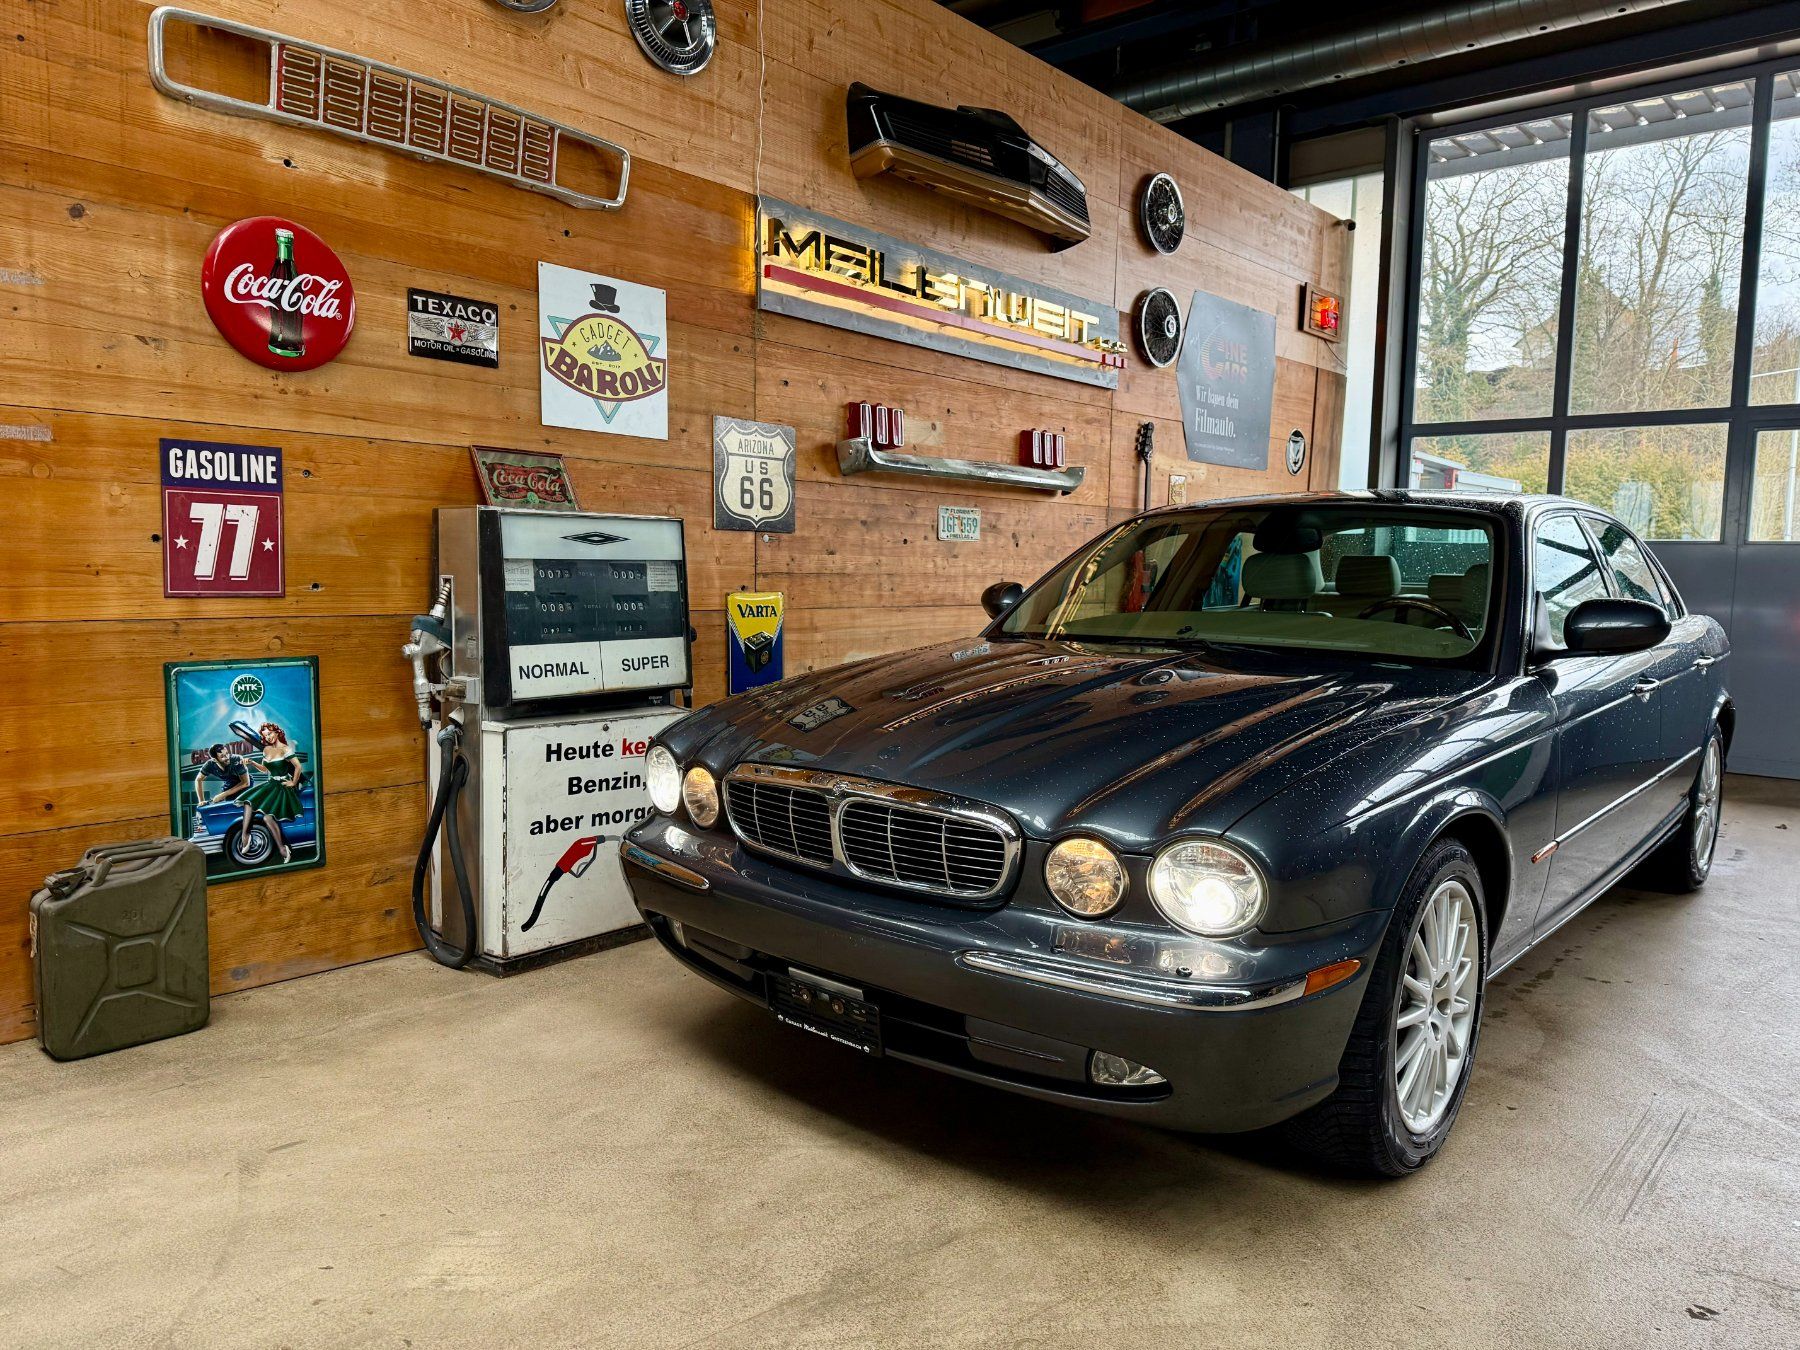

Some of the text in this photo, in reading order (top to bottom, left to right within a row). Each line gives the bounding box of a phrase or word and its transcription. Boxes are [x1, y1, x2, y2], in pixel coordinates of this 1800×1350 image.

[224, 263, 343, 318] Coca-Cola
[413, 296, 496, 324] TEXACO
[415, 340, 441, 350] MOTOR
[443, 344, 455, 352] OIL
[580, 323, 631, 349] GADGET
[550, 346, 661, 396] BARON
[1195, 407, 1236, 438] Filmauto.
[737, 438, 775, 455] ARIZONA
[169, 447, 277, 484] GASOLINE
[740, 476, 773, 511] 66
[189, 502, 260, 581] 77
[737, 604, 777, 618] VARTA
[519, 661, 589, 680] NORMAL
[621, 655, 670, 672] SUPER
[237, 684, 258, 692] NTK
[546, 736, 653, 762] Heute ke
[568, 771, 646, 795] Benzin,
[530, 815, 584, 836] aber
